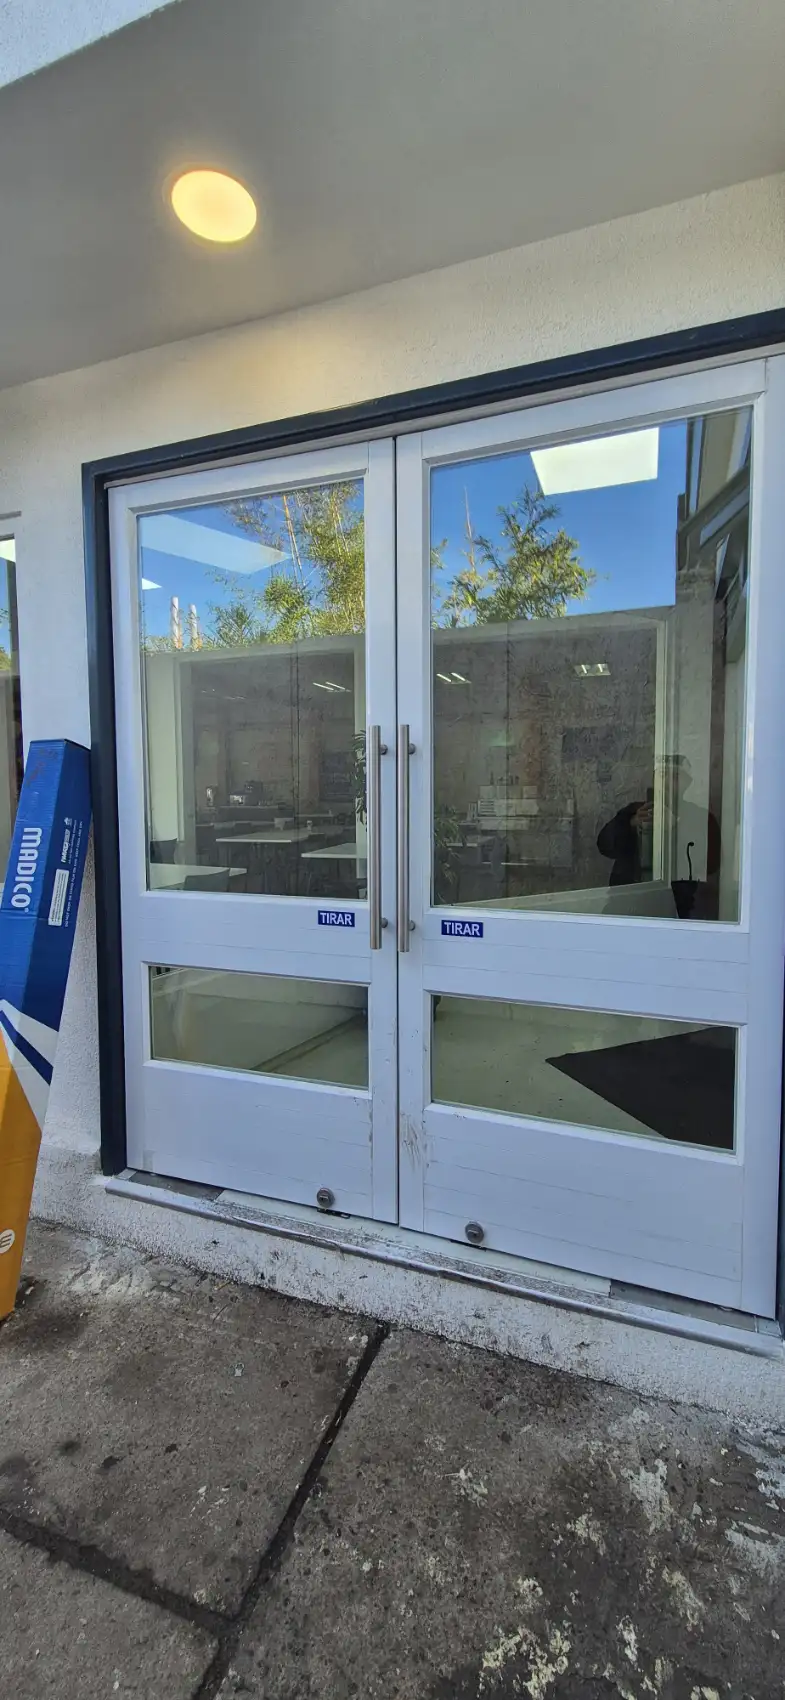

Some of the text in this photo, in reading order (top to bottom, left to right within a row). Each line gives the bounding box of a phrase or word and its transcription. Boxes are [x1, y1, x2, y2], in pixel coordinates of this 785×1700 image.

[11, 828, 42, 908] MADICO
[319, 912, 352, 926] TIRAR
[443, 922, 480, 936] TIRAR
